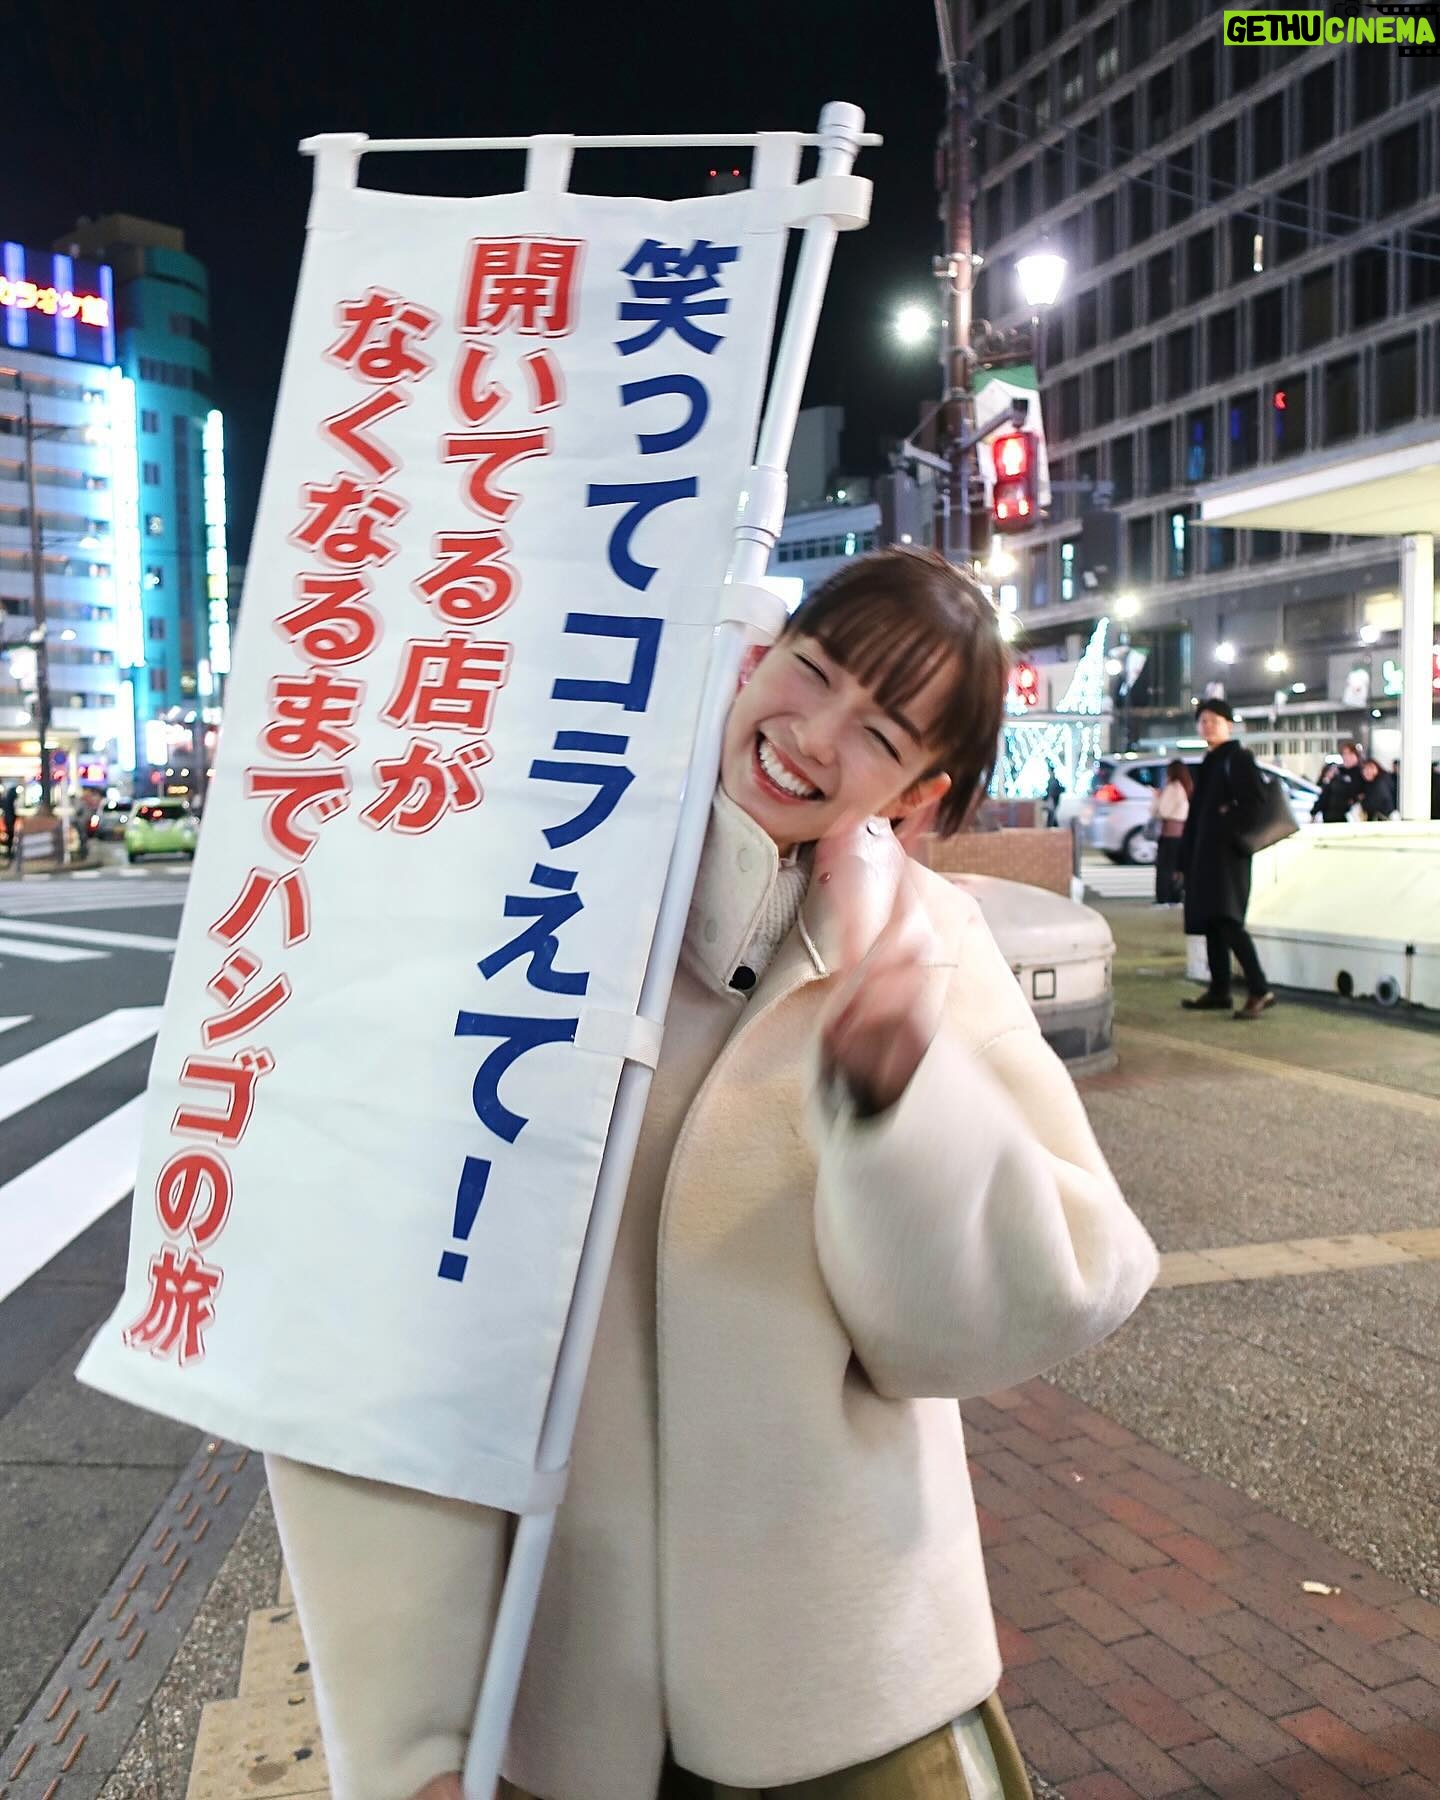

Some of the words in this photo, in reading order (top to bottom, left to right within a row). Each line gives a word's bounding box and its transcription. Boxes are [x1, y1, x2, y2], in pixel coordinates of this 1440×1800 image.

[0, 275, 109, 328] カラオケ
[361, 235, 587, 836] 開いてる店が
[123, 288, 439, 1365] なくなるまでハシゴの旅
[438, 238, 739, 1282] 笑ってコラえて!
